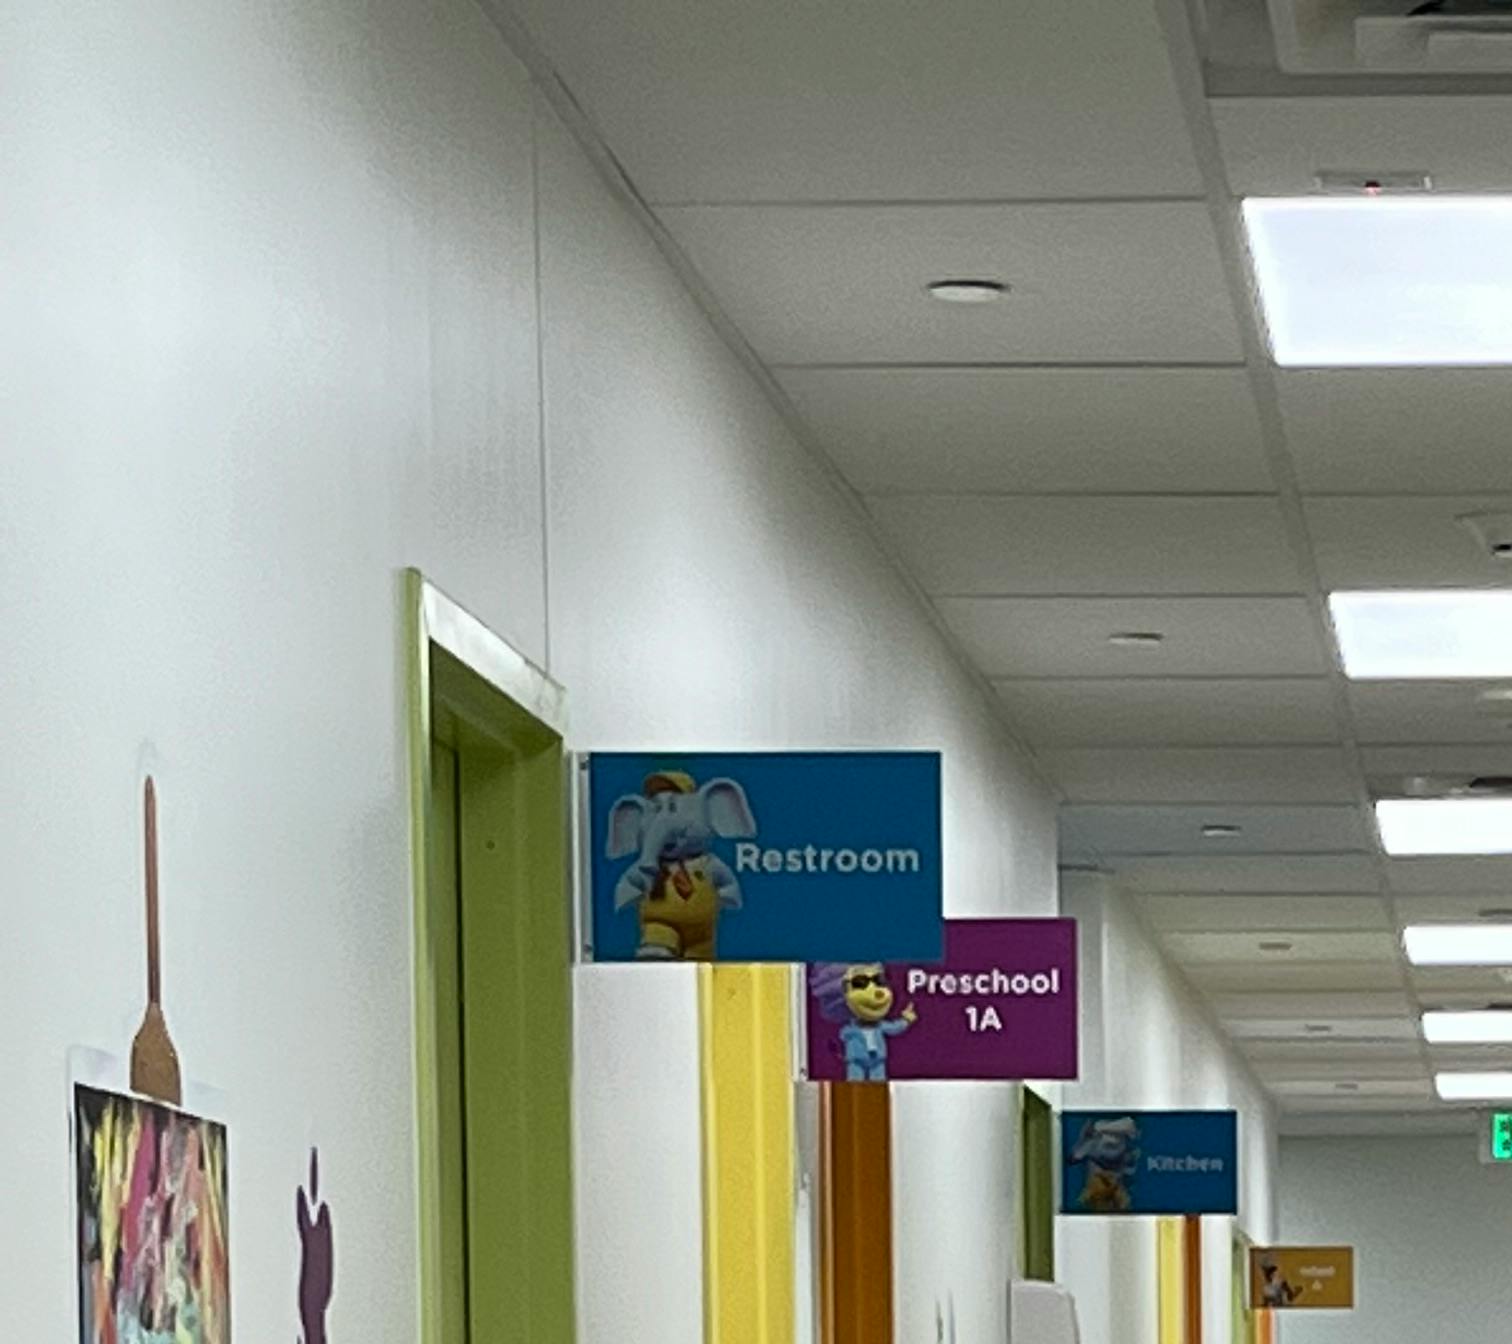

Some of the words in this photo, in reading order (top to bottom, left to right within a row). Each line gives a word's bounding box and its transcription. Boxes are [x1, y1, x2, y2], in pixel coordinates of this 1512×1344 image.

[735, 842, 920, 873] Restroom
[907, 968, 1060, 995] Preschool
[965, 1006, 1003, 1032] 1A
[1147, 1155, 1224, 1172] Kitchen
